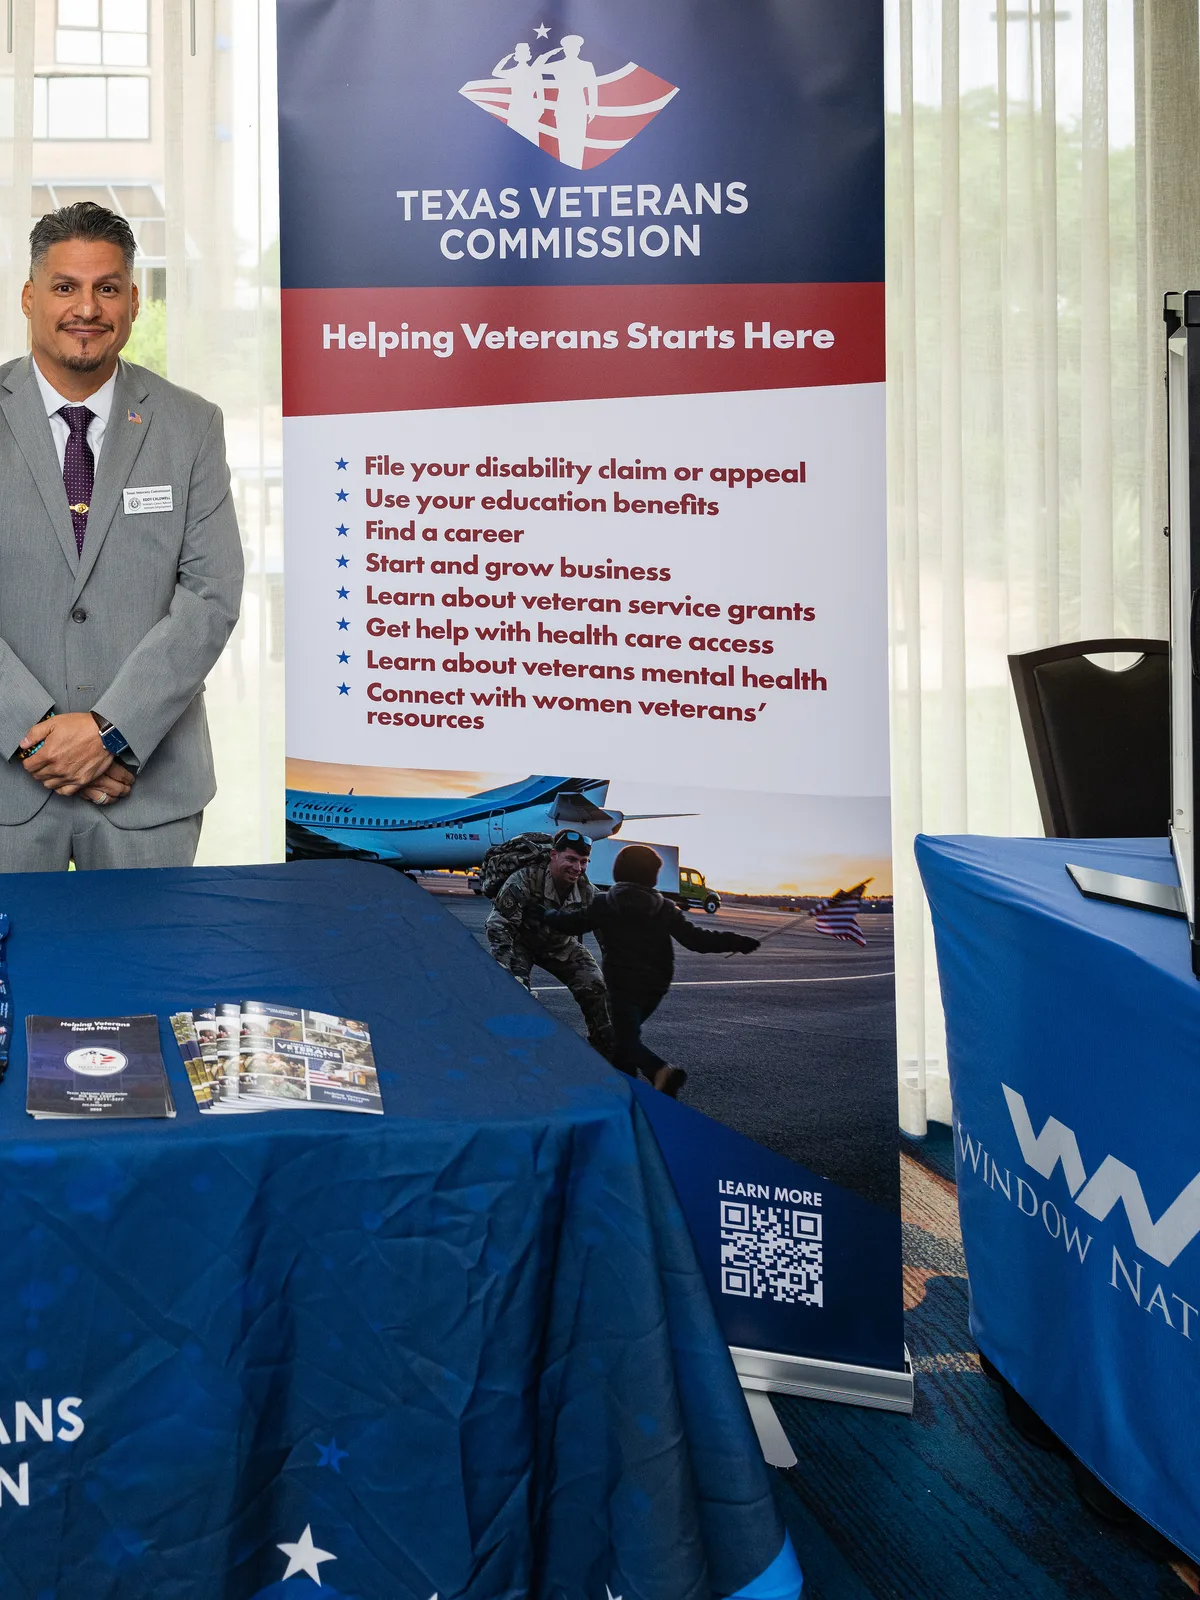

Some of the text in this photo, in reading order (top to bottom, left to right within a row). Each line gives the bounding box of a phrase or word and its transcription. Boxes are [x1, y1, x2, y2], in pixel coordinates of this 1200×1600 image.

[397, 182, 748, 220] TEXAS VETERANS
[440, 225, 700, 260] COMMISSION
[323, 322, 834, 357] Helping Veterans Starts Here
[366, 455, 805, 487] File your disability claim or appeal
[366, 489, 719, 515] Use your education benefits
[366, 520, 524, 543] Find a career
[366, 553, 671, 581] Start and grow business
[367, 586, 815, 624] Learn about veteran service grants
[367, 618, 773, 654] Get help with health care access
[368, 650, 827, 690] Learn about veterans mental health
[367, 683, 766, 722] Connect with women veterans’
[368, 712, 484, 729] resources
[294, 799, 357, 813] PACIFIC
[277, 1042, 341, 1058] VETERANS
[719, 1180, 821, 1206] LEARN MORE
[957, 1121, 1199, 1340] WINDOW NAT
